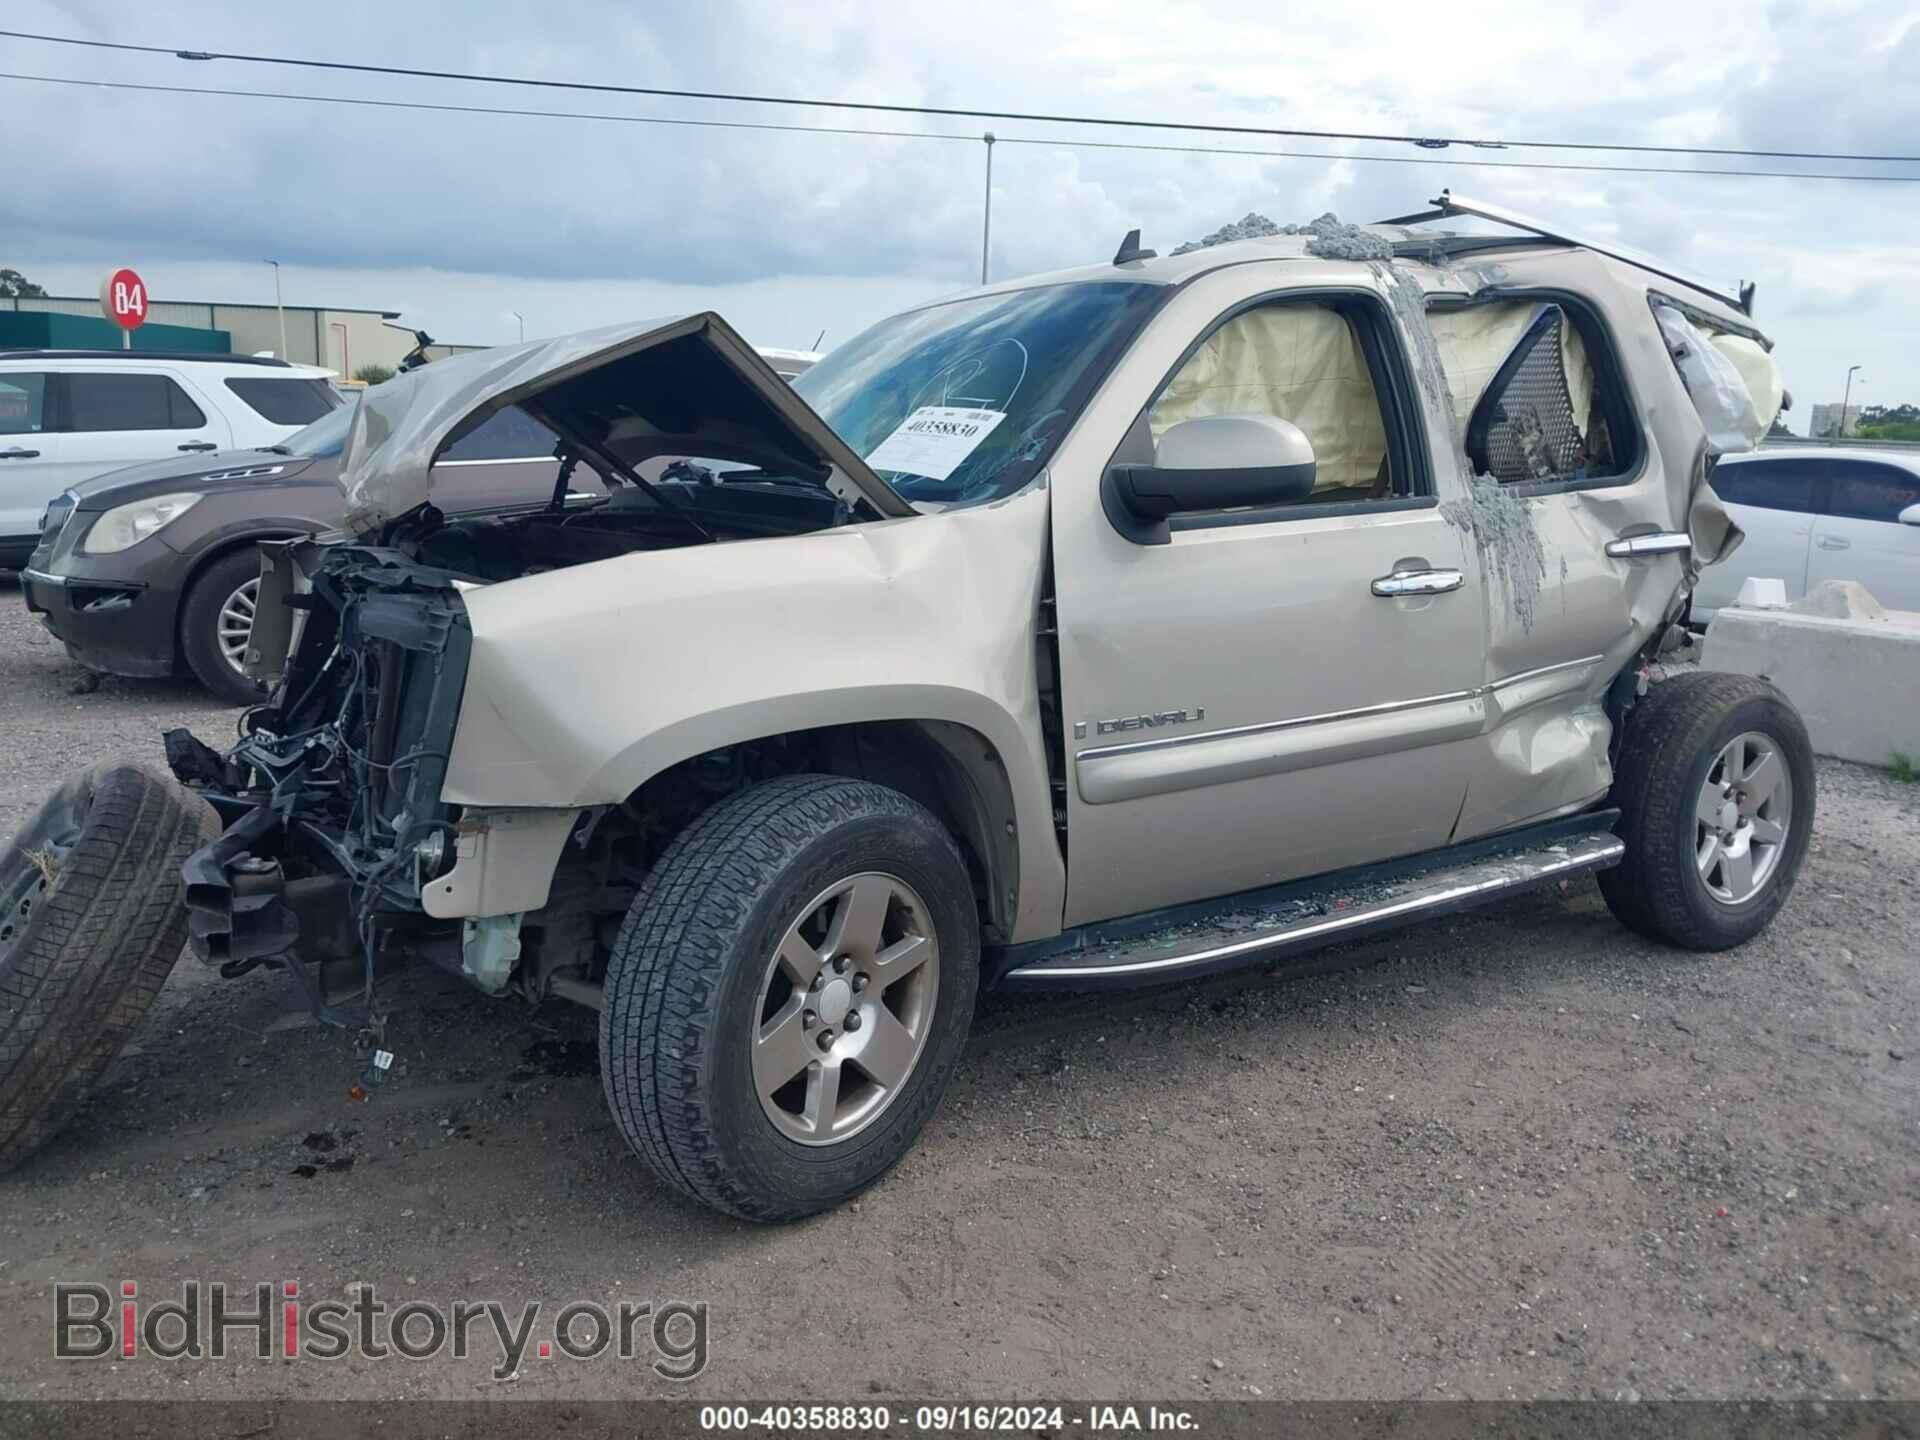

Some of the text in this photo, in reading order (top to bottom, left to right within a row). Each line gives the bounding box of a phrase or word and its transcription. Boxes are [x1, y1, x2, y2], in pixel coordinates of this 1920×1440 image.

[115, 282, 143, 316] 84
[908, 420, 979, 437] 40358830
[1097, 707, 1205, 735] DENALI
